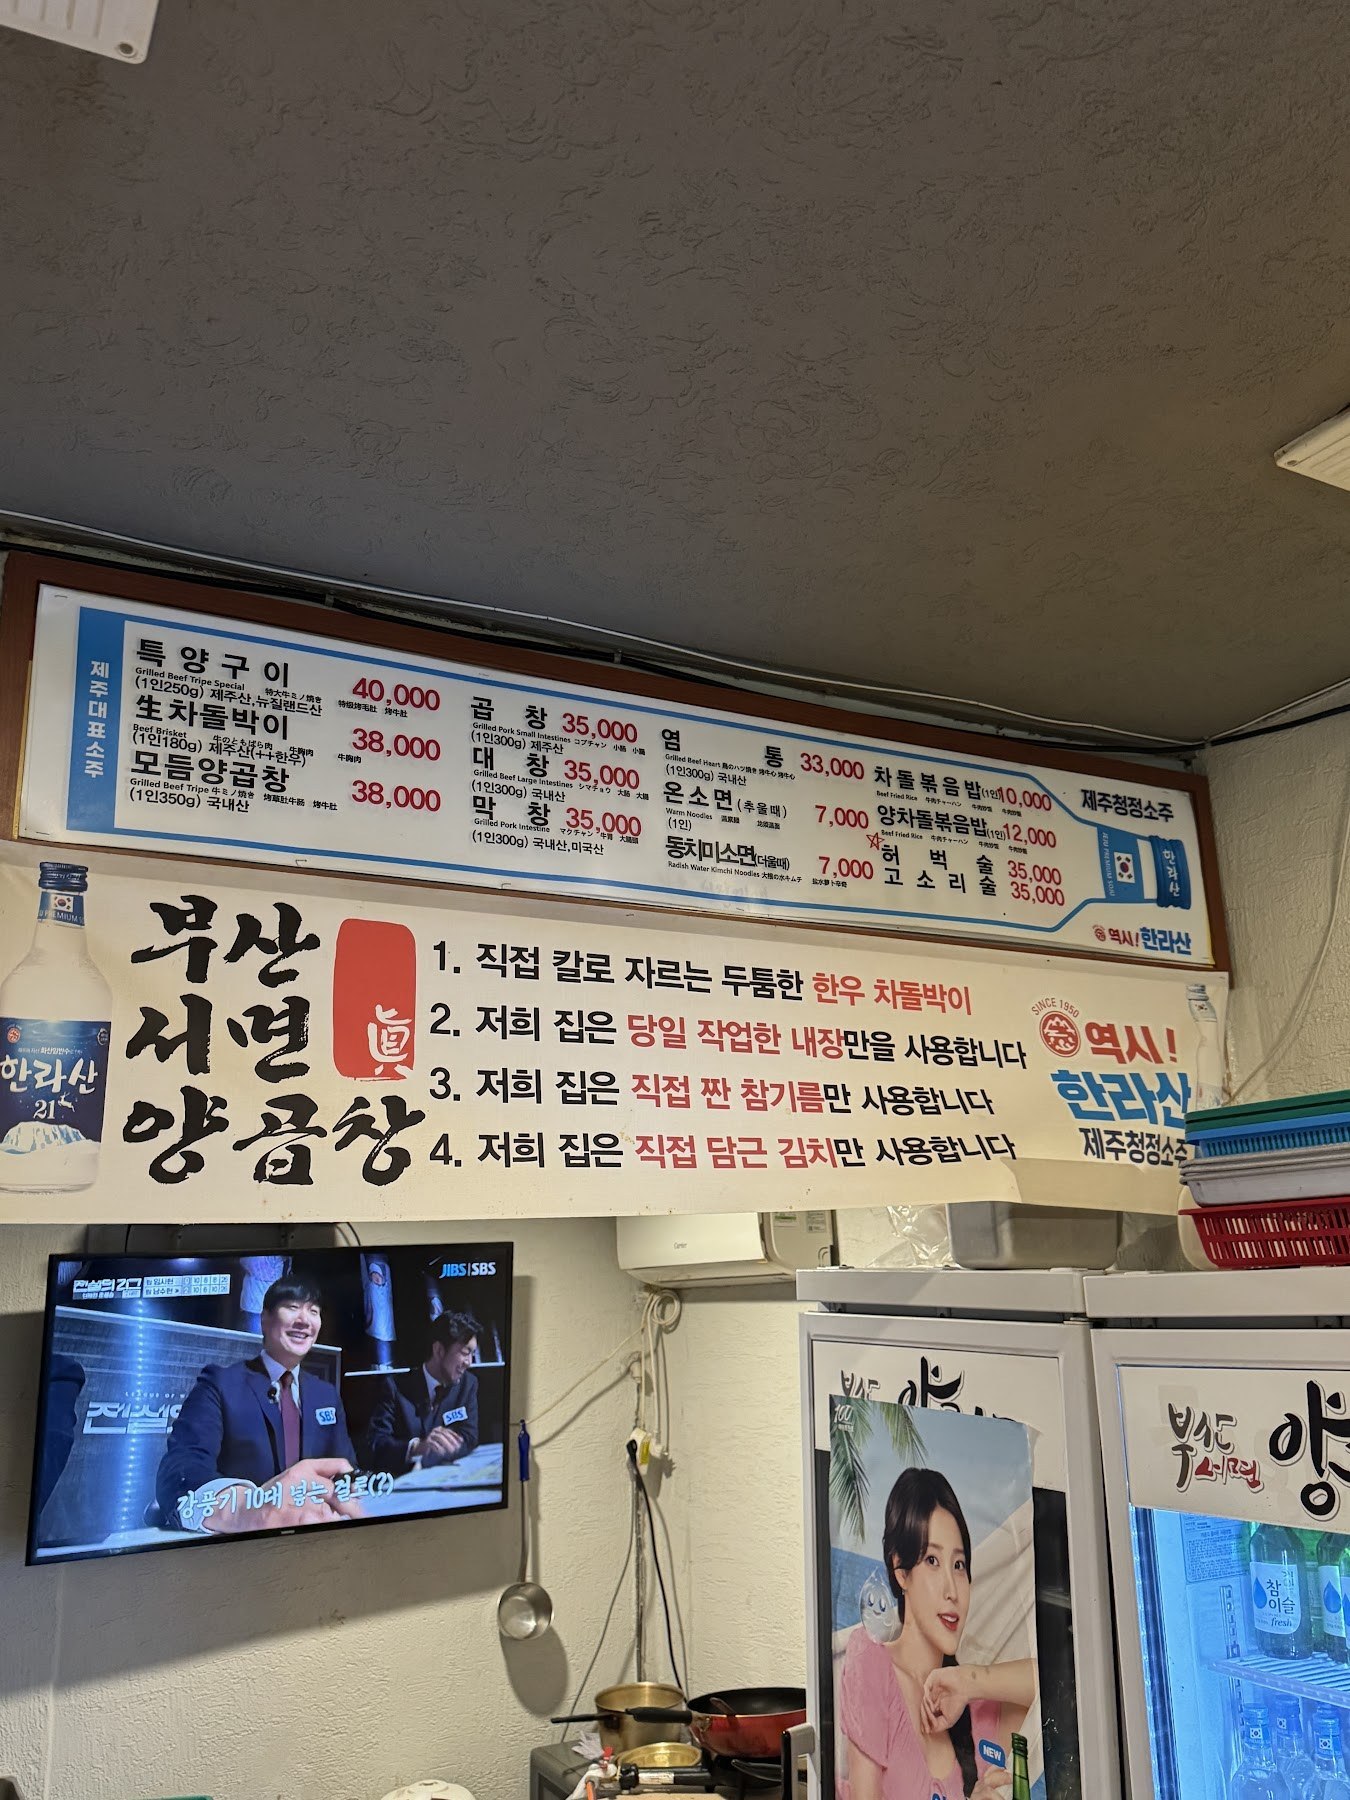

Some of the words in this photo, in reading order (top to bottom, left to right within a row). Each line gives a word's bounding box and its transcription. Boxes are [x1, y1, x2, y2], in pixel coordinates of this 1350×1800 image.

[135, 667, 165, 678] Grilled
[168, 672, 187, 682] Beef
[190, 675, 212, 686] Tripe
[214, 679, 245, 690] Special
[136, 639, 289, 687] 특양구이
[352, 678, 440, 711] 40,000
[135, 677, 204, 699] (1인250g)
[210, 689, 322, 716] 제주산,뉴질랜드산
[84, 660, 109, 778] 제주대표소주
[133, 724, 154, 734] Beef
[156, 727, 186, 738] Brisket
[562, 713, 637, 743] 35,000
[132, 733, 202, 754] (1인180g)
[352, 728, 440, 761] 38,000
[471, 729, 525, 750] (1인300g)
[531, 742, 563, 754] 제주산
[473, 722, 497, 733] Grilled
[499, 726, 515, 736] Pork
[516, 729, 536, 738] Small
[537, 732, 571, 744] Intestines
[666, 754, 686, 763] Grilled
[703, 759, 720, 768] Heart
[800, 752, 864, 780] 33,000
[130, 778, 161, 788] Grilled
[164, 781, 184, 791] Beef
[186, 784, 210, 795] Tripe
[131, 750, 289, 792] 모듬양곱창
[352, 780, 440, 812] 38,000
[473, 769, 498, 780] Grilled
[500, 773, 515, 782] Beef
[517, 776, 537, 786] Large
[539, 777, 573, 789] Intestines
[564, 760, 639, 790] 35,000
[666, 764, 713, 781] (1인300g)
[718, 773, 746, 786] 국내산
[129, 787, 201, 809] (1인350g)
[206, 797, 249, 813] 국내산
[472, 779, 526, 799] (1인300g)
[532, 790, 565, 803] 국내산
[998, 787, 1052, 812] 10,000
[663, 781, 732, 811] 온소면
[815, 805, 869, 829] 7,000
[666, 807, 685, 815] Warm
[687, 810, 712, 820] Noodles
[1080, 788, 1174, 823] 제주청정소주
[474, 818, 498, 828] Grilled
[500, 821, 517, 830] Pork
[519, 822, 550, 833] Intestine
[566, 807, 641, 837] 35,000
[669, 817, 692, 831] (1인)
[1003, 823, 1056, 848] 12,000
[473, 830, 528, 849] (1인300g)
[533, 837, 604, 855] 국내산,미국산
[668, 861, 689, 870] Radish
[691, 864, 709, 872] Water
[735, 869, 759, 878] Noodles
[818, 856, 873, 880] 7,000
[1008, 860, 1062, 886] 35,000
[1011, 881, 1065, 906] 35,000
[131, 894, 321, 988] 부산
[1108, 928, 1139, 947] 역시!
[1140, 927, 1192, 955] 한라산
[433, 941, 460, 973] 1.
[476, 943, 539, 980] 직접
[553, 950, 615, 984] 칼로
[625, 956, 712, 993] 자르는
[722, 965, 803, 1001] 두툼한
[812, 972, 865, 1006] 한우
[874, 979, 972, 1015] 차돌박이
[1031, 997, 1056, 1016] SINCE
[1059, 999, 1079, 1018] 1950
[126, 993, 311, 1083] 서면
[430, 1003, 460, 1036] 2.
[476, 1005, 539, 1041] 저희
[554, 1010, 617, 1044] 집은
[627, 1015, 686, 1050] 당일
[697, 1019, 781, 1055] 작업한
[791, 1025, 896, 1062] 내장만을
[905, 1034, 1027, 1070] 사용합니다
[1085, 1022, 1178, 1064] 역시!
[0, 1057, 99, 1095] 한라산
[430, 1067, 460, 1101] 3.
[476, 1068, 542, 1104] 저희
[555, 1071, 619, 1105] 집은
[631, 1074, 690, 1108] 직접
[700, 1078, 731, 1110] 짠
[740, 1078, 852, 1114] 참기름만
[862, 1085, 994, 1115] 사용합니다
[1050, 1070, 1191, 1130] 한라산
[34, 1100, 56, 1119] 21
[123, 1085, 426, 1185] 양곱창
[430, 1133, 461, 1167] 4.
[478, 1131, 545, 1168] 저희
[558, 1133, 623, 1168] 집은
[635, 1135, 697, 1169] 직접
[707, 1136, 767, 1169] 담근
[778, 1137, 866, 1168] 김치만
[876, 1134, 1016, 1166] 사용합니다
[439, 1264, 467, 1278] JIBS
[471, 1262, 496, 1276] SBS
[1168, 1403, 1234, 1488] 부산
[1269, 1380, 1350, 1516] 양
[1195, 1455, 1261, 1489] 서면
[177, 1488, 237, 1519] 강풍기
[245, 1486, 283, 1510] 10대
[290, 1480, 327, 1509] 넣는
[334, 1472, 395, 1502] 걸로(?)
[1271, 1618, 1292, 1626] fresh
[983, 1744, 1002, 1761] NEW
